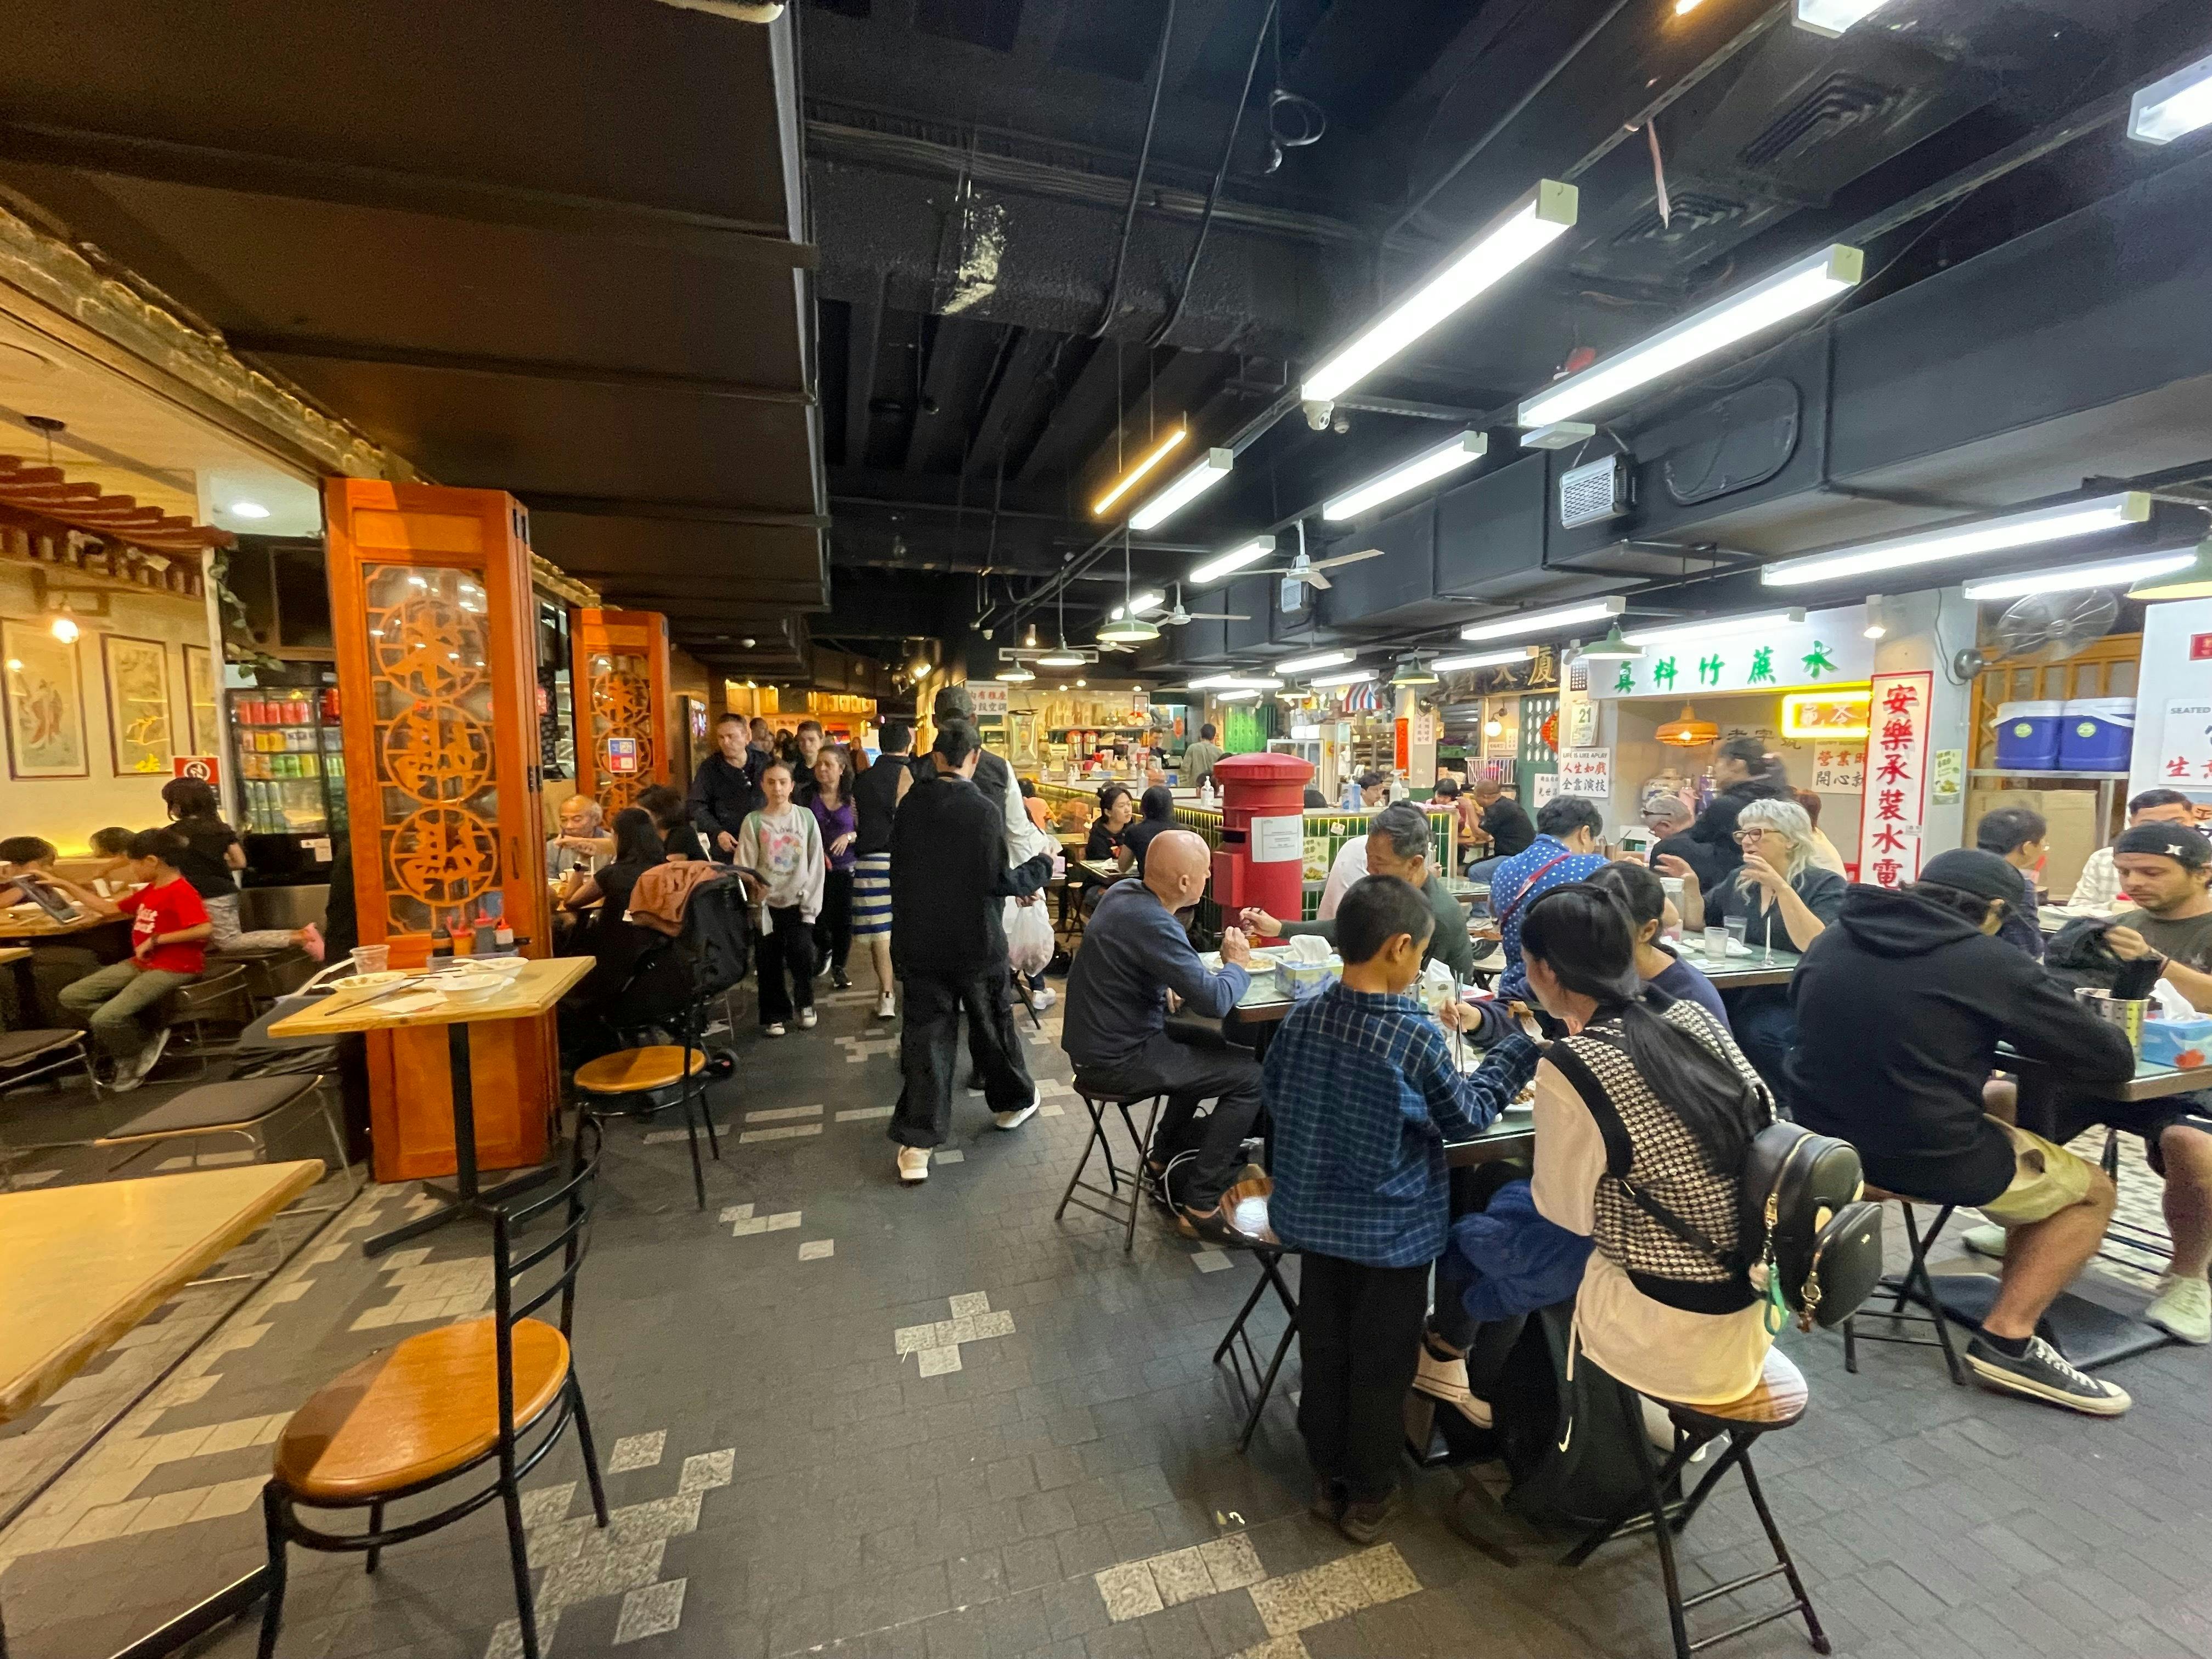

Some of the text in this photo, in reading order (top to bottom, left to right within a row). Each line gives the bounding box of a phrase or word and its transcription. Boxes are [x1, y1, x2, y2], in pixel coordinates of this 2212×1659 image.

[1614, 640, 1841, 694] 真料竹蔗水
[1578, 707, 1592, 724] 21
[2170, 706, 2211, 714] SEATED
[1872, 684, 1918, 891] 安樂承裝水電
